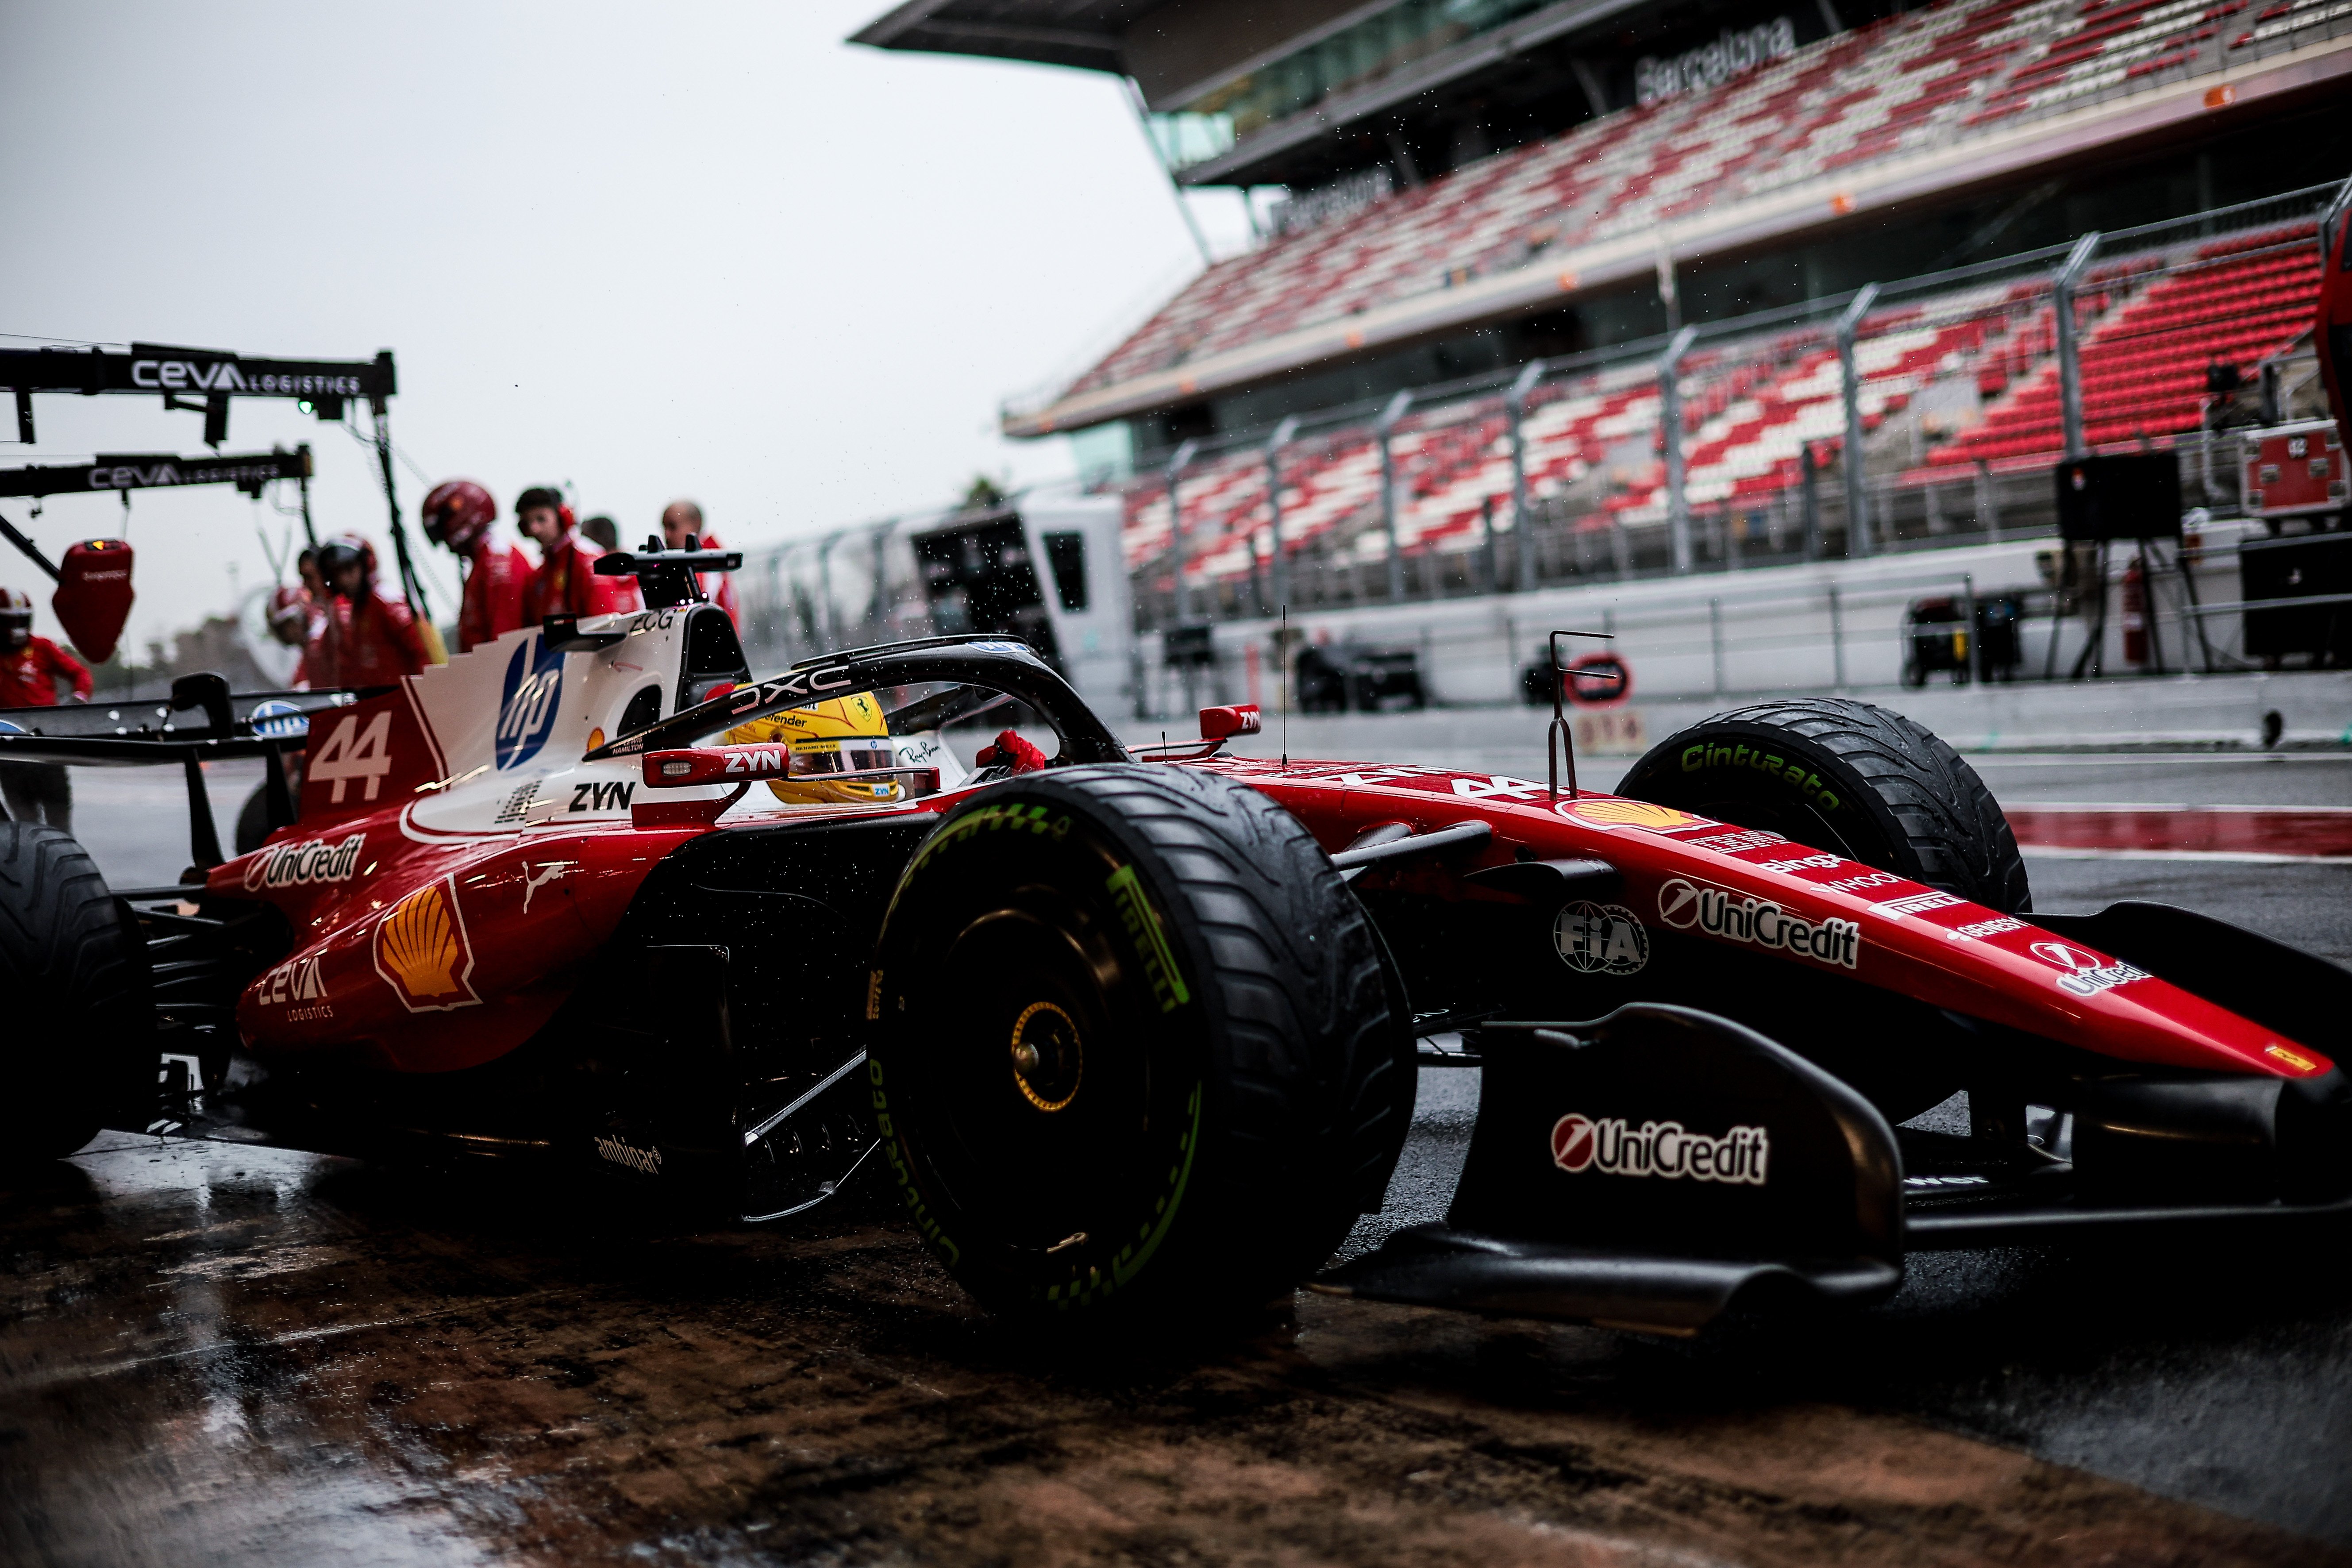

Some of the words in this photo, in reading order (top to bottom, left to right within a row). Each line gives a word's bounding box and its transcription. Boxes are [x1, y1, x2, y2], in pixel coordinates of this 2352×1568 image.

[1635, 15, 1795, 105] Barcelona
[248, 374, 361, 395] LOGISTICS
[762, 715, 807, 727] efender
[1240, 711, 1260, 729] ZYN
[309, 711, 392, 803] 44
[612, 743, 644, 755] HAMILTON
[725, 749, 781, 773] ZYN
[569, 782, 636, 812] ZYN
[1451, 775, 1574, 799] 44
[1684, 830, 1791, 854] IBM
[267, 837, 361, 884] UniCredit
[1867, 890, 1969, 921] PIRELL
[1105, 863, 1191, 1014] PIRELLI
[1701, 889, 1856, 965] UniCredit
[1956, 916, 2035, 938] GENESY
[2059, 963, 2151, 996] UniCred
[288, 1006, 333, 1022] LOGISTICS
[1597, 1121, 1765, 1180] UniCredit
